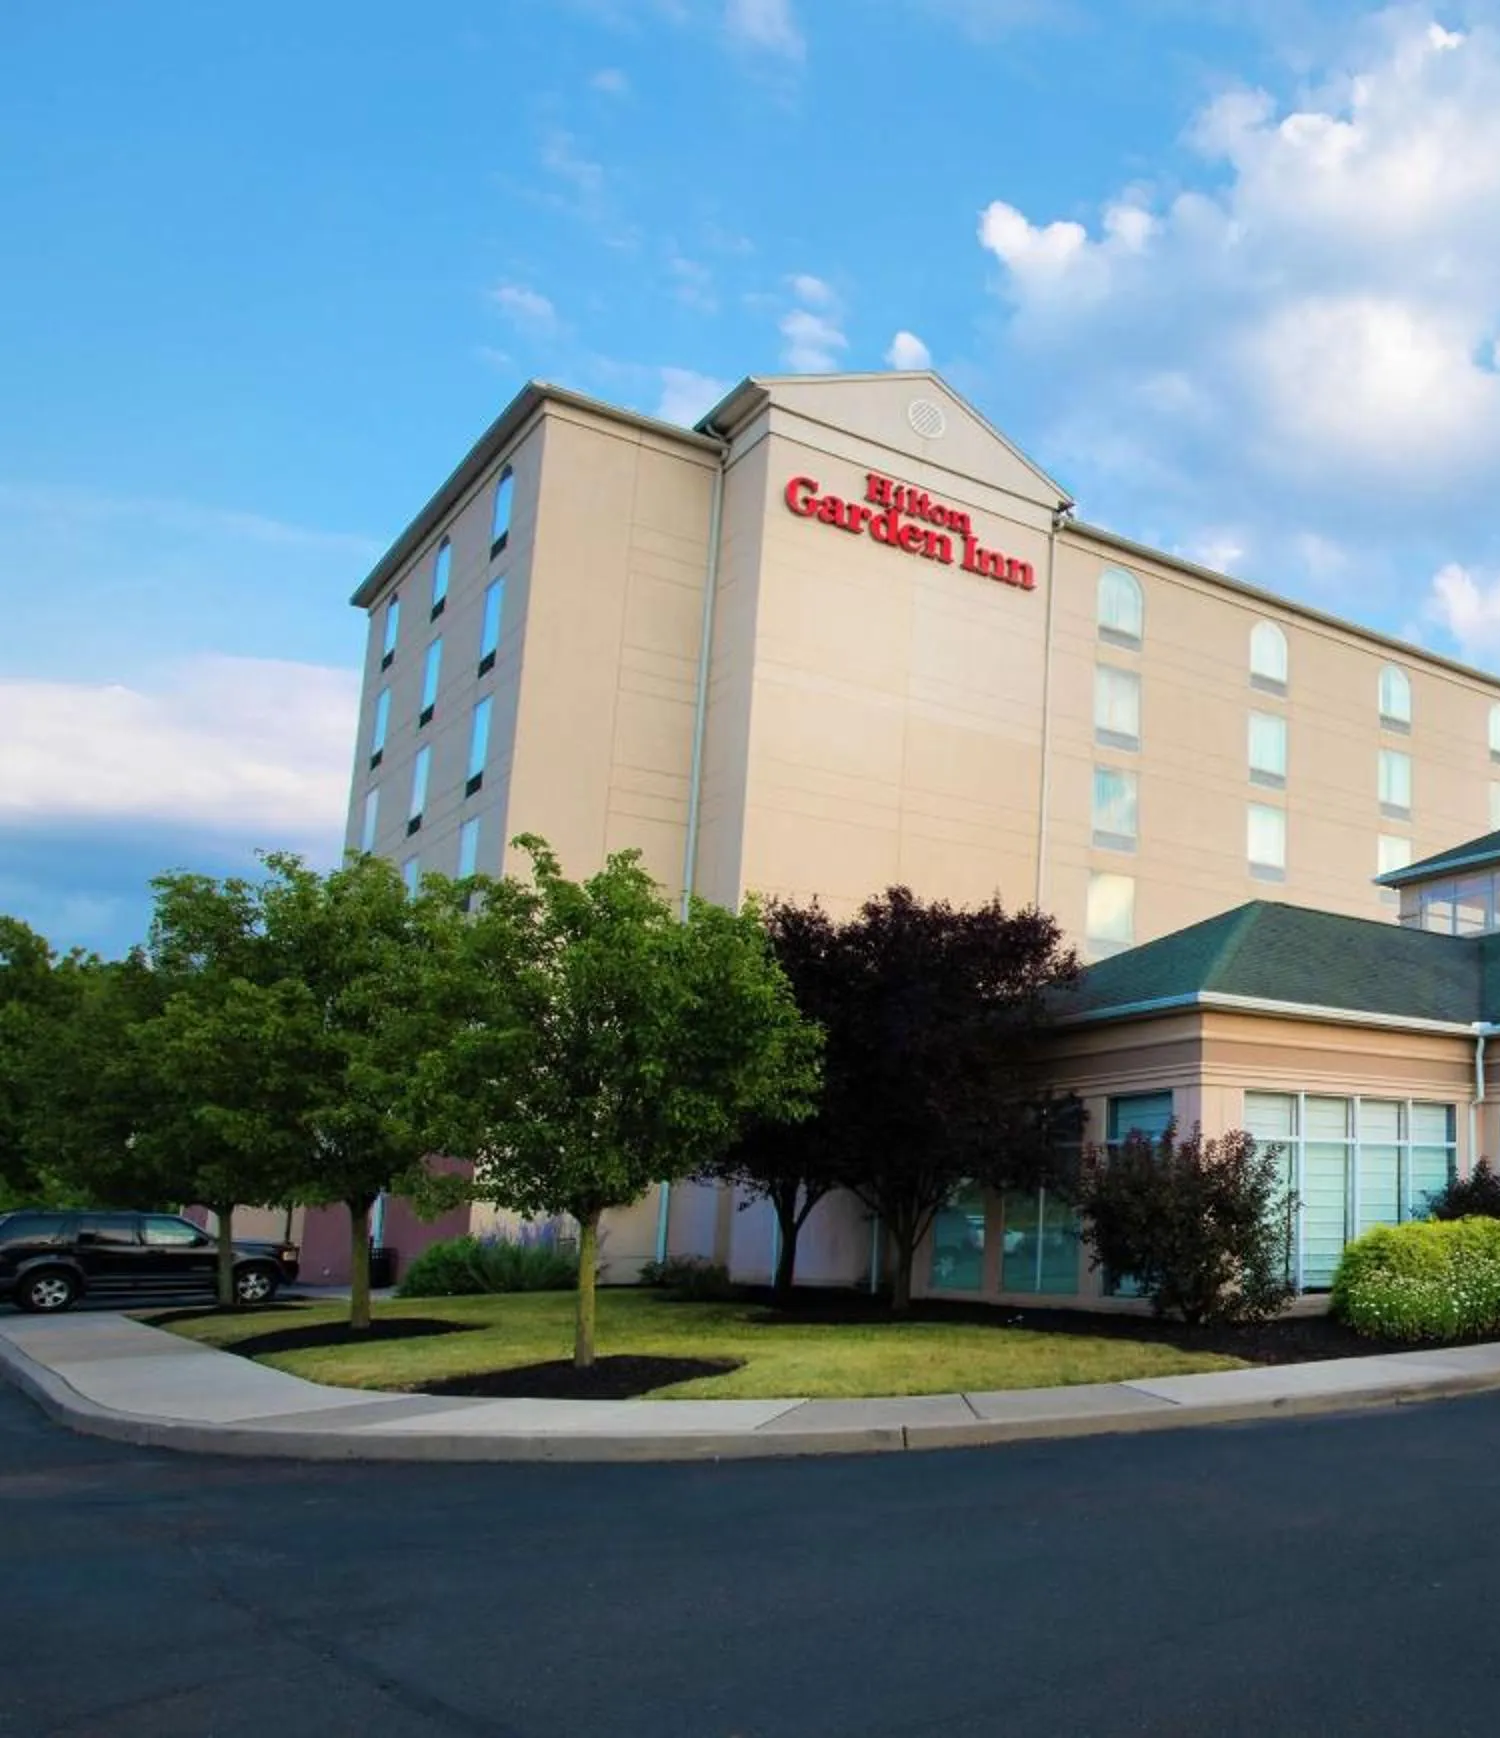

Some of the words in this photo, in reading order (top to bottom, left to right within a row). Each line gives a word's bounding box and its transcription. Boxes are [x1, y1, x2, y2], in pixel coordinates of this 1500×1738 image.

[785, 476, 953, 565] Garden
[960, 534, 1035, 590] Inn
[865, 472, 972, 534] Hilton
